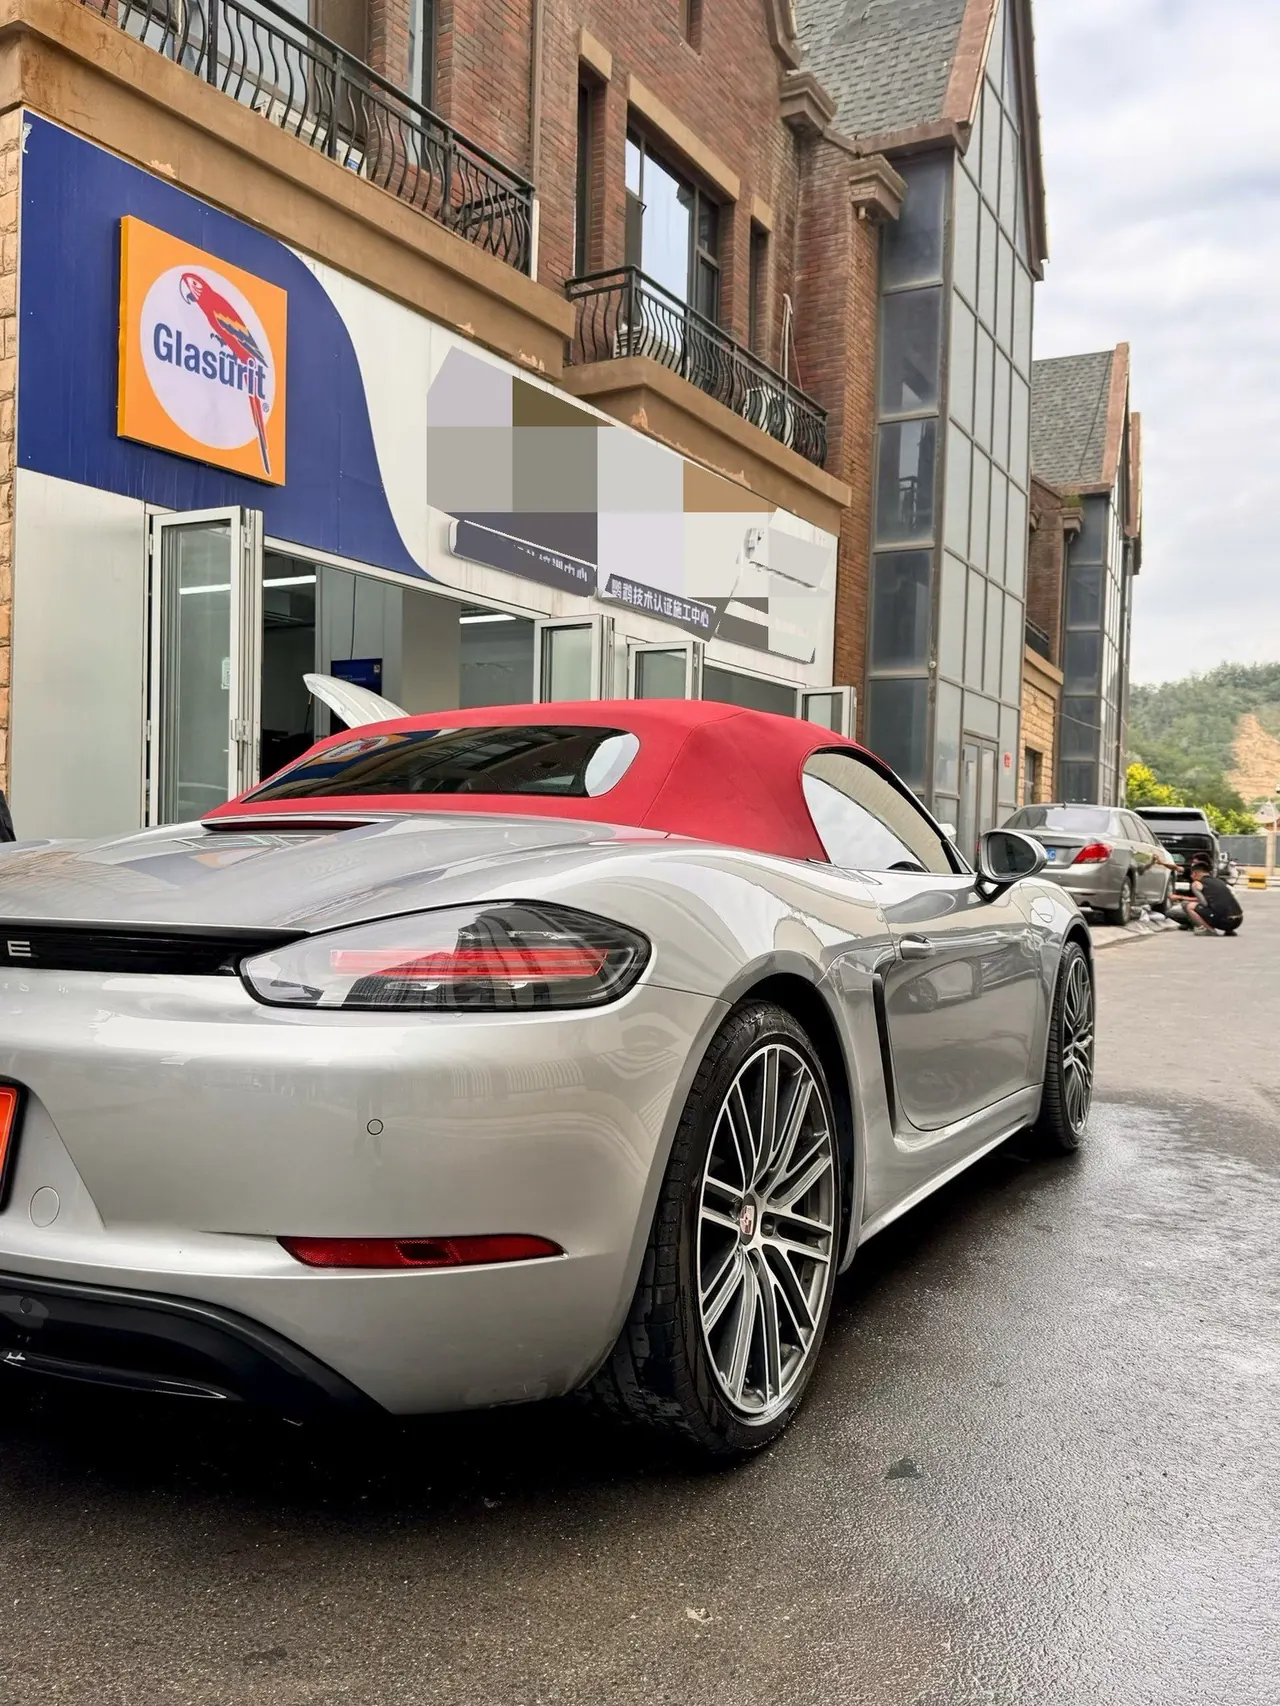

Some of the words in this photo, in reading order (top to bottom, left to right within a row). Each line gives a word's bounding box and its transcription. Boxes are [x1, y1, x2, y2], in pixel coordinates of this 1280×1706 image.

[153, 322, 266, 400] Glasurit
[611, 578, 710, 628] 鹦鹉技术认证施工中心
[7, 940, 32, 957] E
